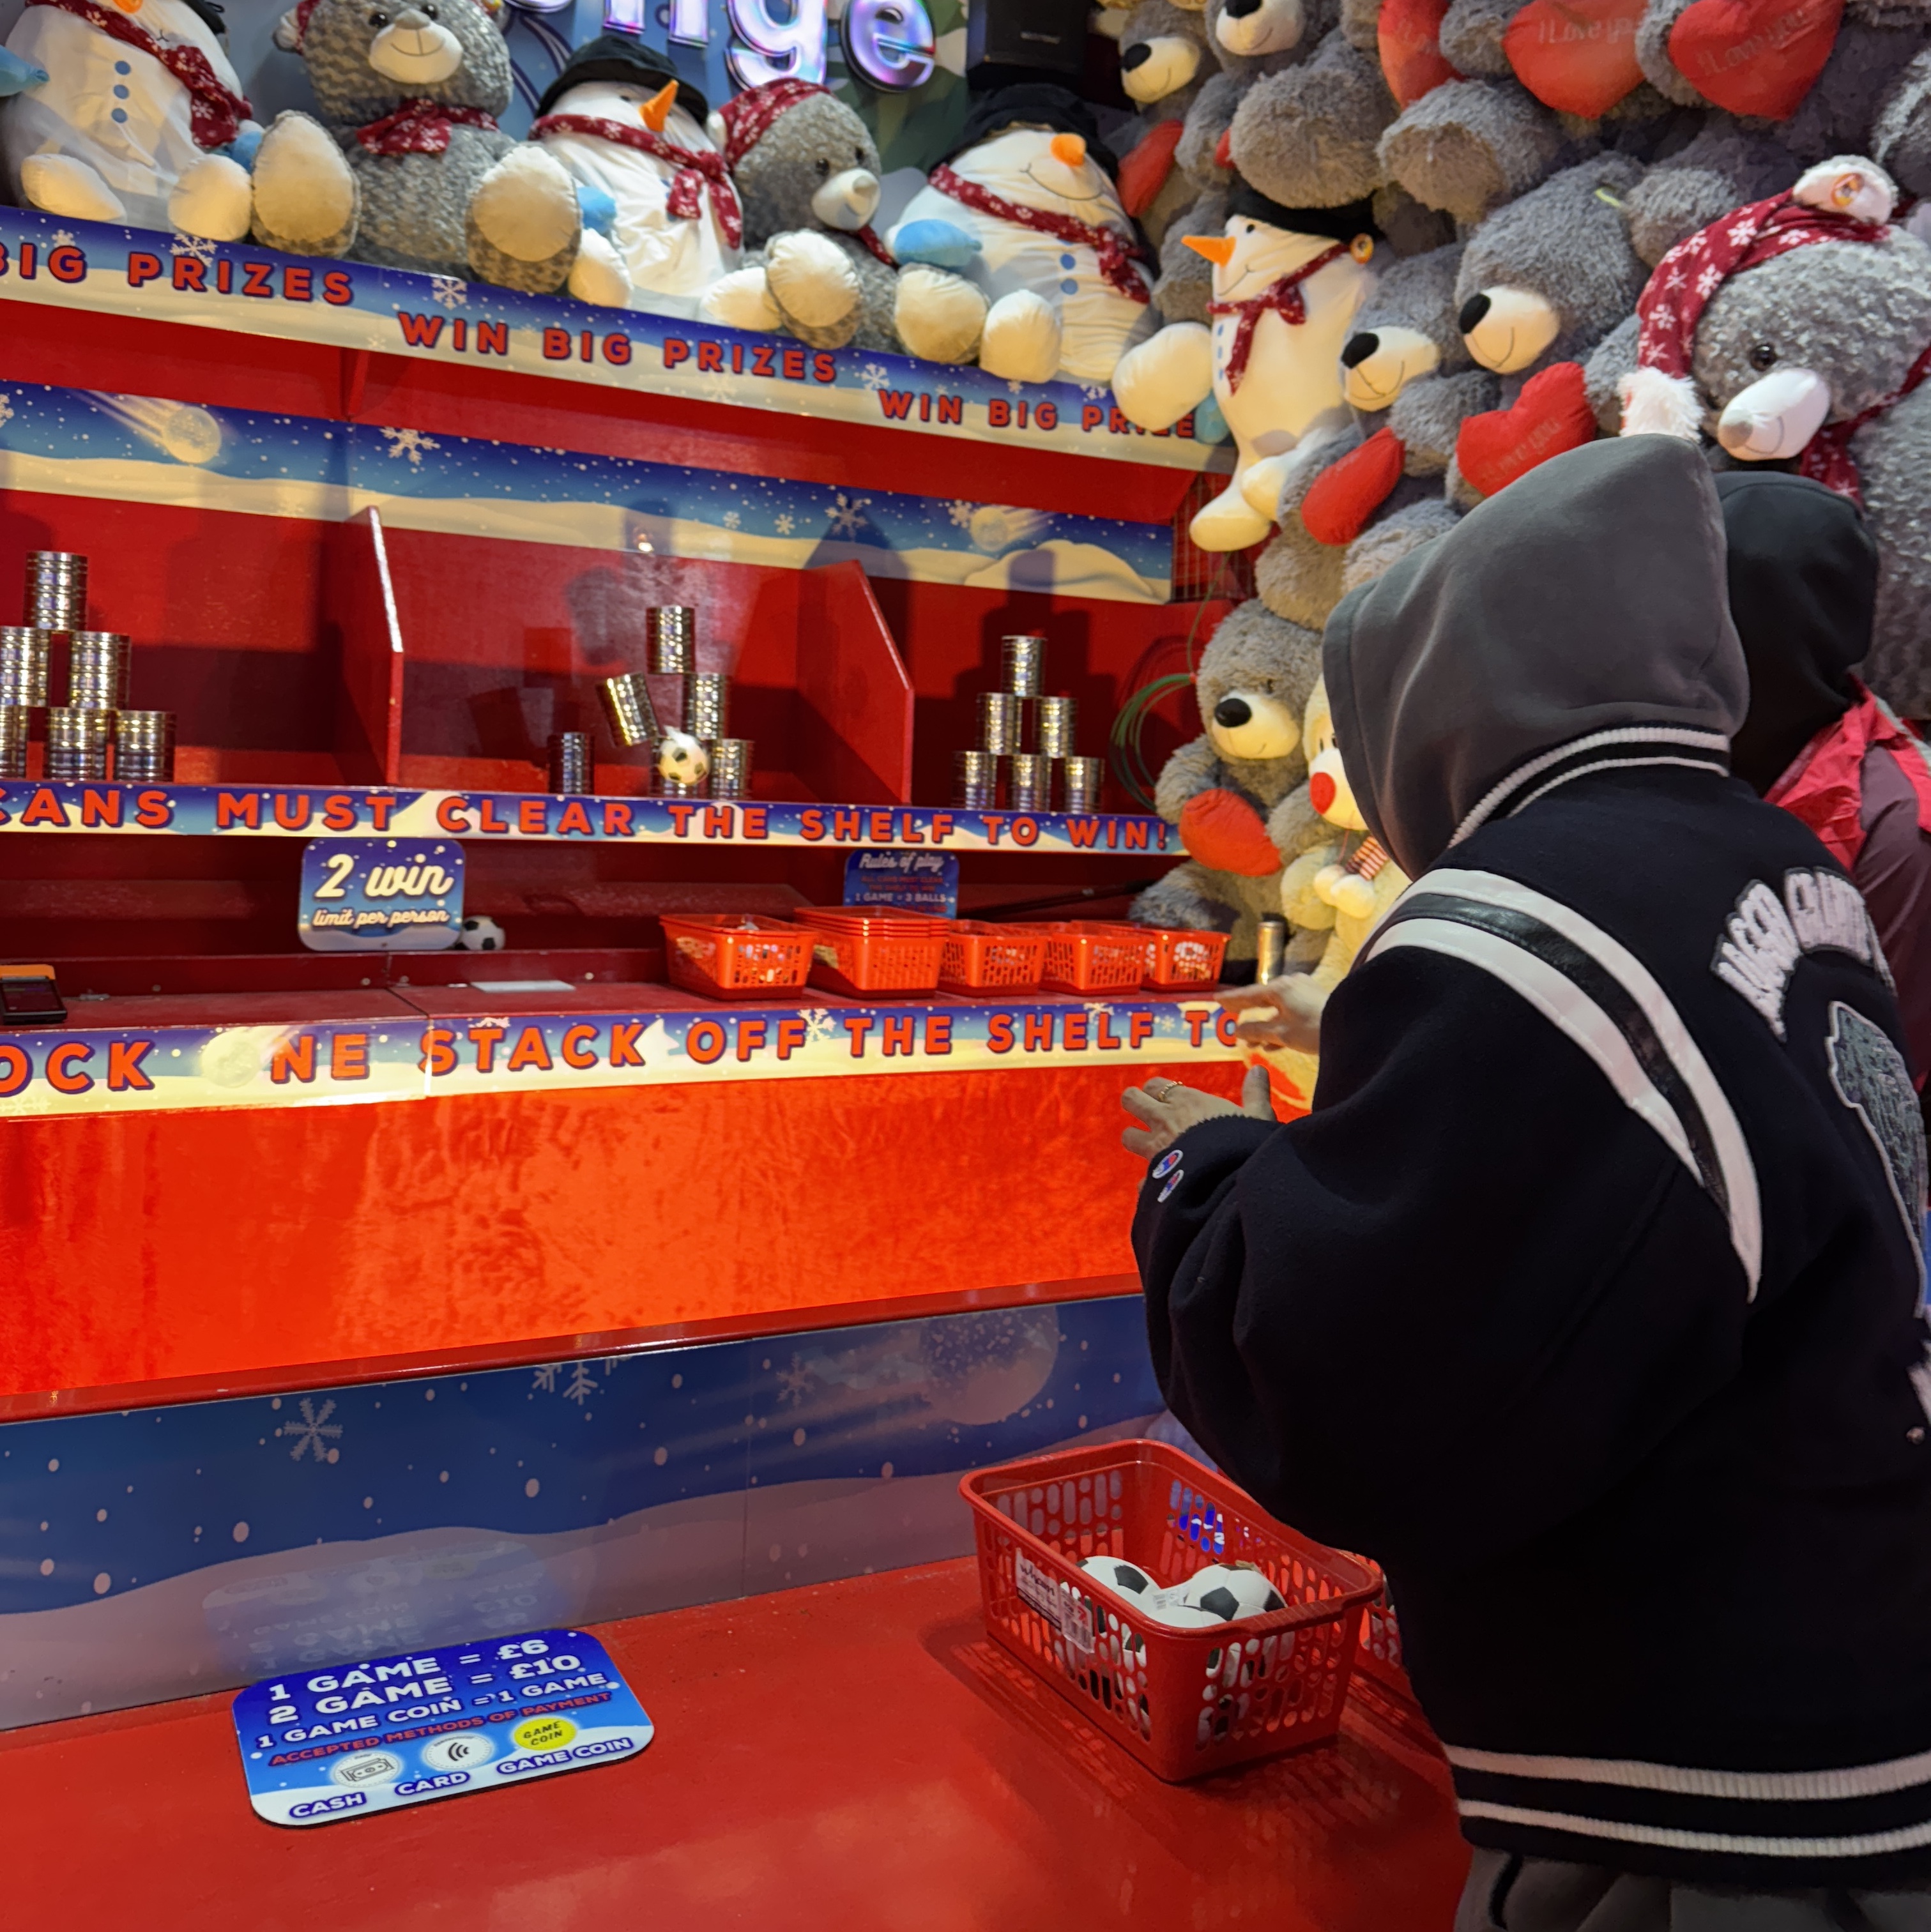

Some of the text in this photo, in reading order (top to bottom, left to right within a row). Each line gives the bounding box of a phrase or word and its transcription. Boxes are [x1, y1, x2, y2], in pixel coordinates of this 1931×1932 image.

[128, 252, 353, 305] PRIZES
[397, 312, 837, 383] WIN BIG PRIZES
[878, 389, 1194, 438] WIN BIG PRE
[217, 792, 397, 831] MUST
[436, 796, 635, 836] CLEAR
[668, 805, 768, 839] THE
[800, 809, 954, 844] SHELF
[982, 815, 1040, 846] TO
[1066, 818, 1166, 849] WIN!
[314, 853, 454, 898] 2 win
[859, 851, 945, 873] Rules of play
[312, 909, 450, 929] limit per person
[863, 893, 894, 902] GAME
[905, 894, 912, 902] 3
[915, 894, 947, 902] BALLS
[418, 1023, 647, 1076] STACK
[686, 1019, 807, 1064] OFF
[844, 1014, 952, 1058] THE
[987, 1012, 1154, 1054] SHELF
[269, 1639, 549, 1701] 1 GAME = £6
[269, 1655, 581, 1724] 2 GAME = £10
[259, 1735, 274, 1748] 1
[284, 1715, 378, 1742] GAME
[388, 1700, 462, 1722] COIN
[498, 1690, 514, 1702] 1
[521, 1673, 607, 1696] GAME
[270, 1737, 380, 1767] ACCEPTED
[386, 1716, 484, 1743] METHODS
[488, 1710, 517, 1723] OF
[522, 1692, 611, 1716] PAYMENT
[523, 1721, 561, 1739] GAME
[531, 1730, 563, 1746] COIN
[292, 1738, 632, 1816] CASH CARD GAME COIN
